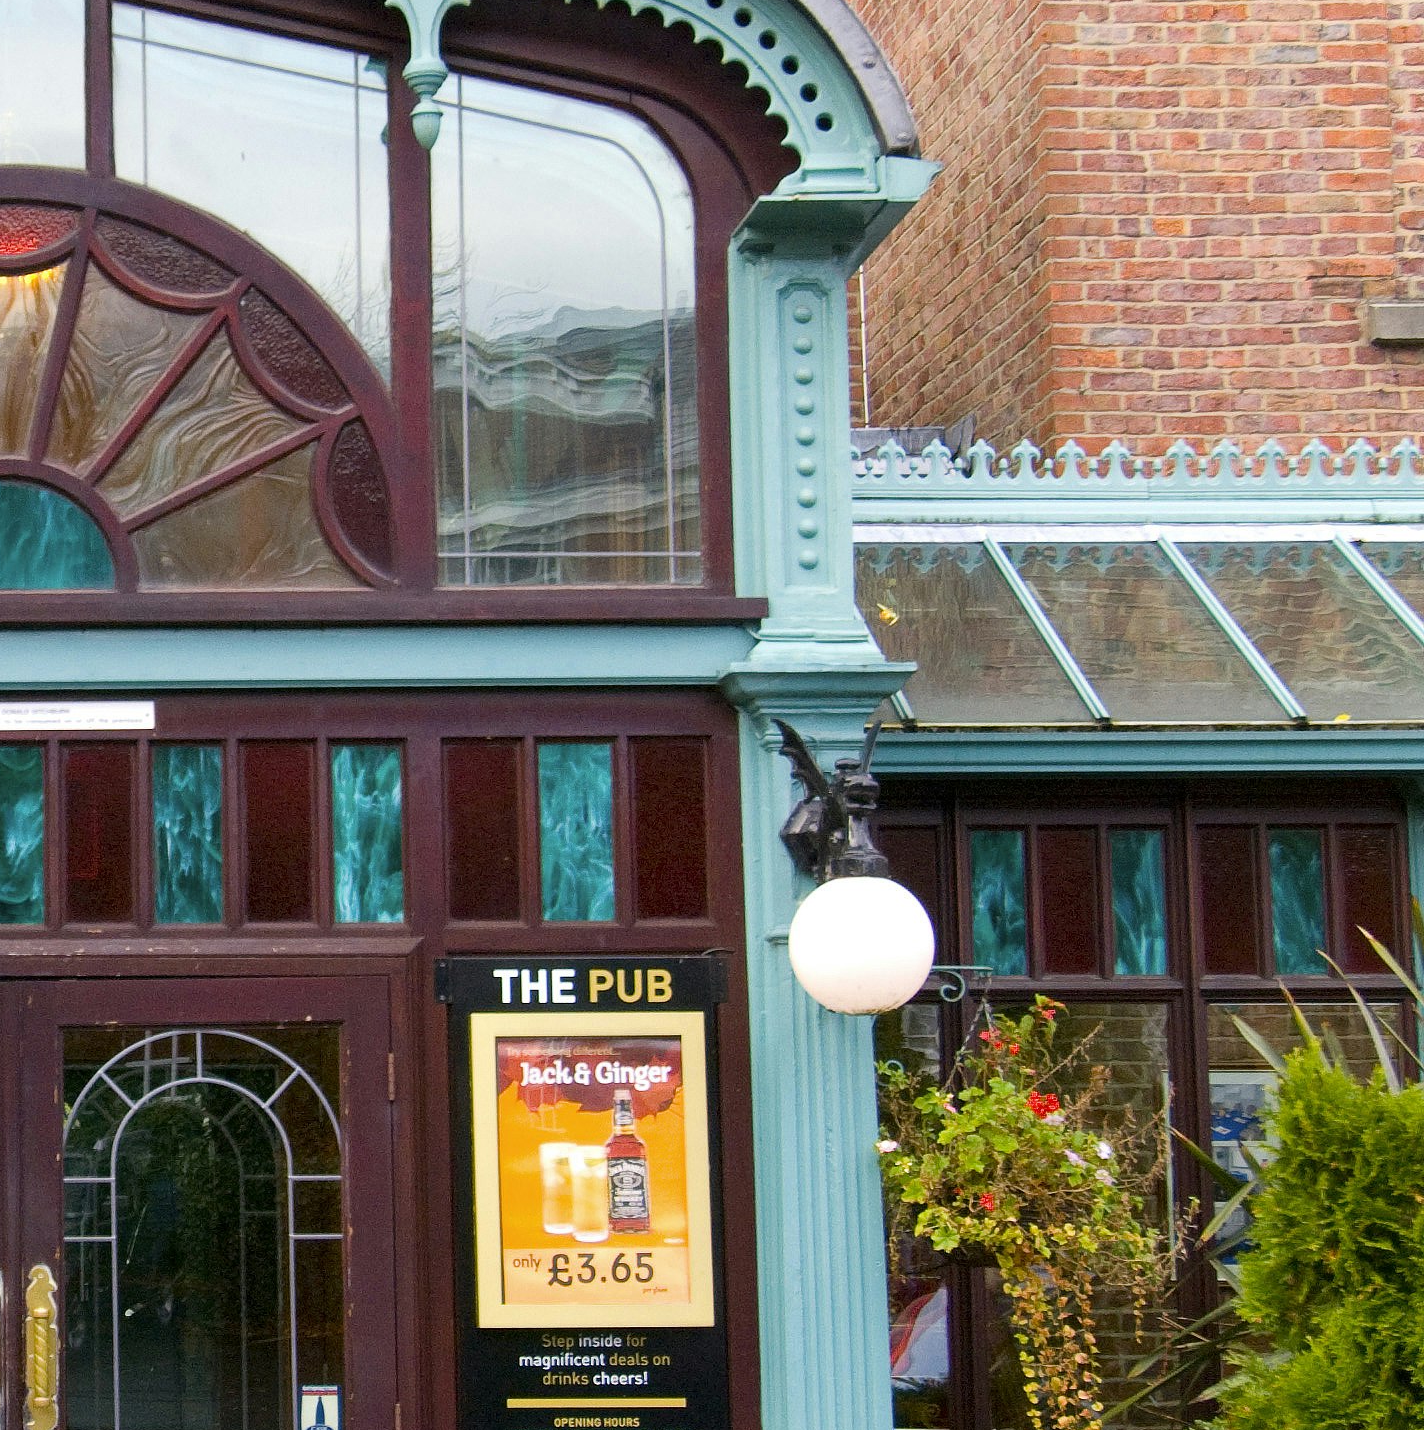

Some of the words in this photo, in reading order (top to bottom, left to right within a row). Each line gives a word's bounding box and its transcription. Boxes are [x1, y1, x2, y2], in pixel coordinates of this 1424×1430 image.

[493, 969, 576, 1003] THE
[589, 969, 672, 1002] PUB
[520, 1059, 573, 1086] Jack
[574, 1062, 591, 1085] &
[595, 1061, 672, 1091] Ginger
[512, 1254, 541, 1271] only
[548, 1252, 654, 1287] £3.65
[542, 1334, 574, 1350] Step
[578, 1334, 622, 1347] inside
[627, 1334, 646, 1346] for
[519, 1353, 605, 1369] magnificent
[609, 1353, 648, 1366] deals
[652, 1356, 670, 1366] on
[542, 1372, 589, 1385] drinks
[593, 1372, 648, 1385] cheers!
[554, 1418, 601, 1427] OPENING
[604, 1418, 640, 1427] HOURS
